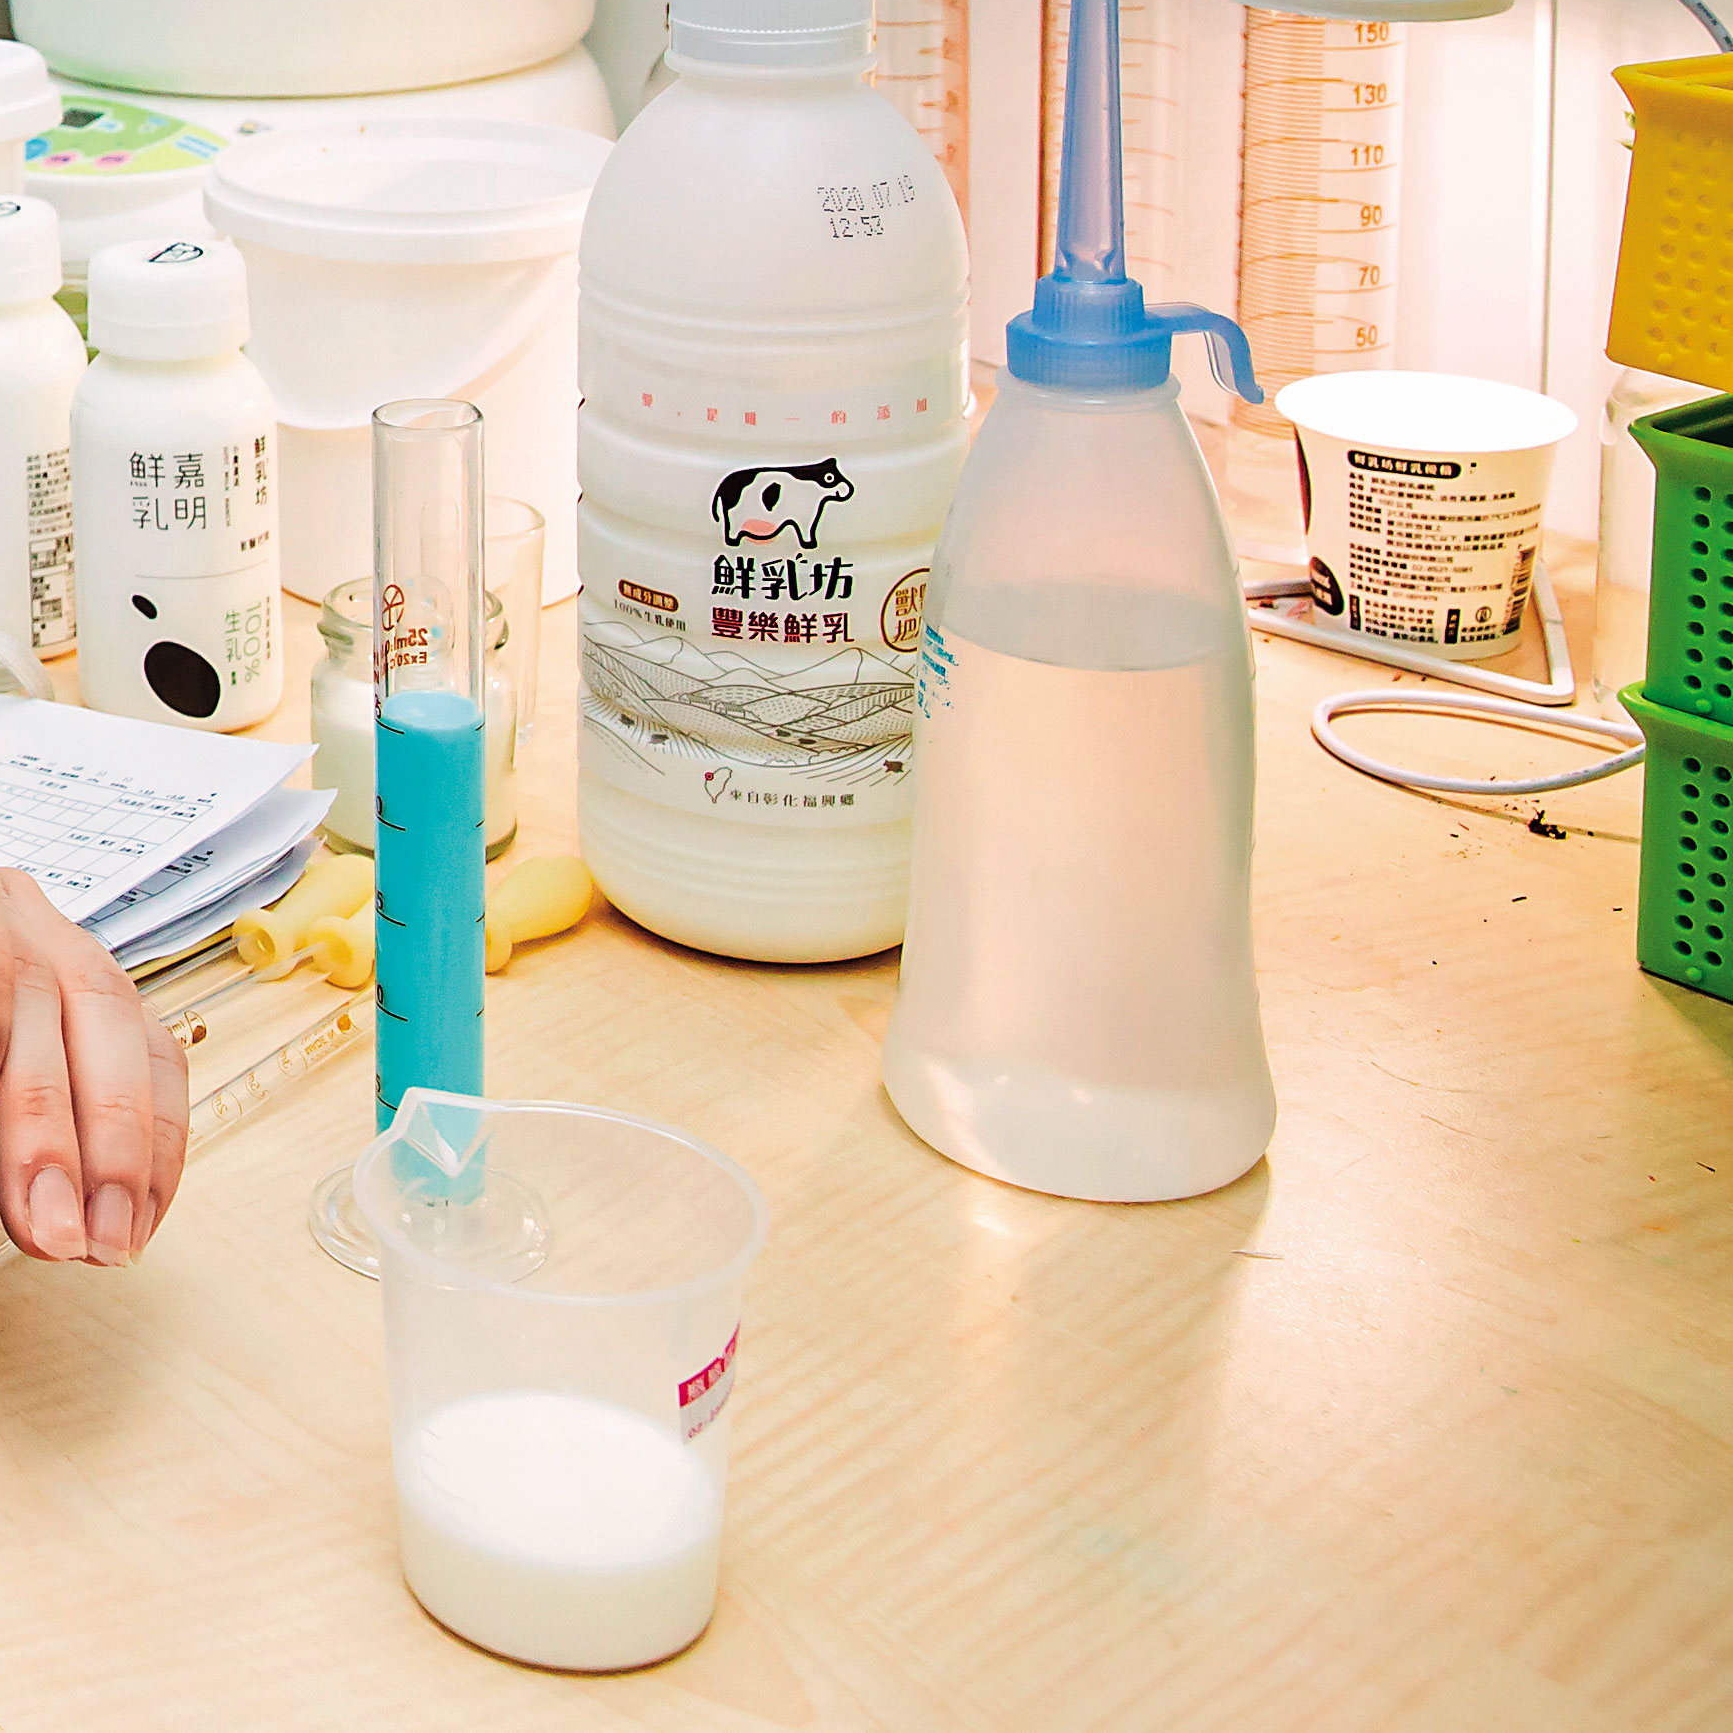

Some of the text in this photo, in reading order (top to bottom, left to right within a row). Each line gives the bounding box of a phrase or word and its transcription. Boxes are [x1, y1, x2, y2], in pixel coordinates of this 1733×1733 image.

[1355, 22, 1390, 44] 150
[1353, 83, 1388, 105] 130
[1351, 145, 1384, 167] 110
[1360, 204, 1383, 228] 90
[1357, 265, 1381, 287] 70
[1355, 324, 1378, 347] 50
[711, 552, 854, 601] 鮮乳坊
[710, 606, 855, 644] 豐樂鮮乳
